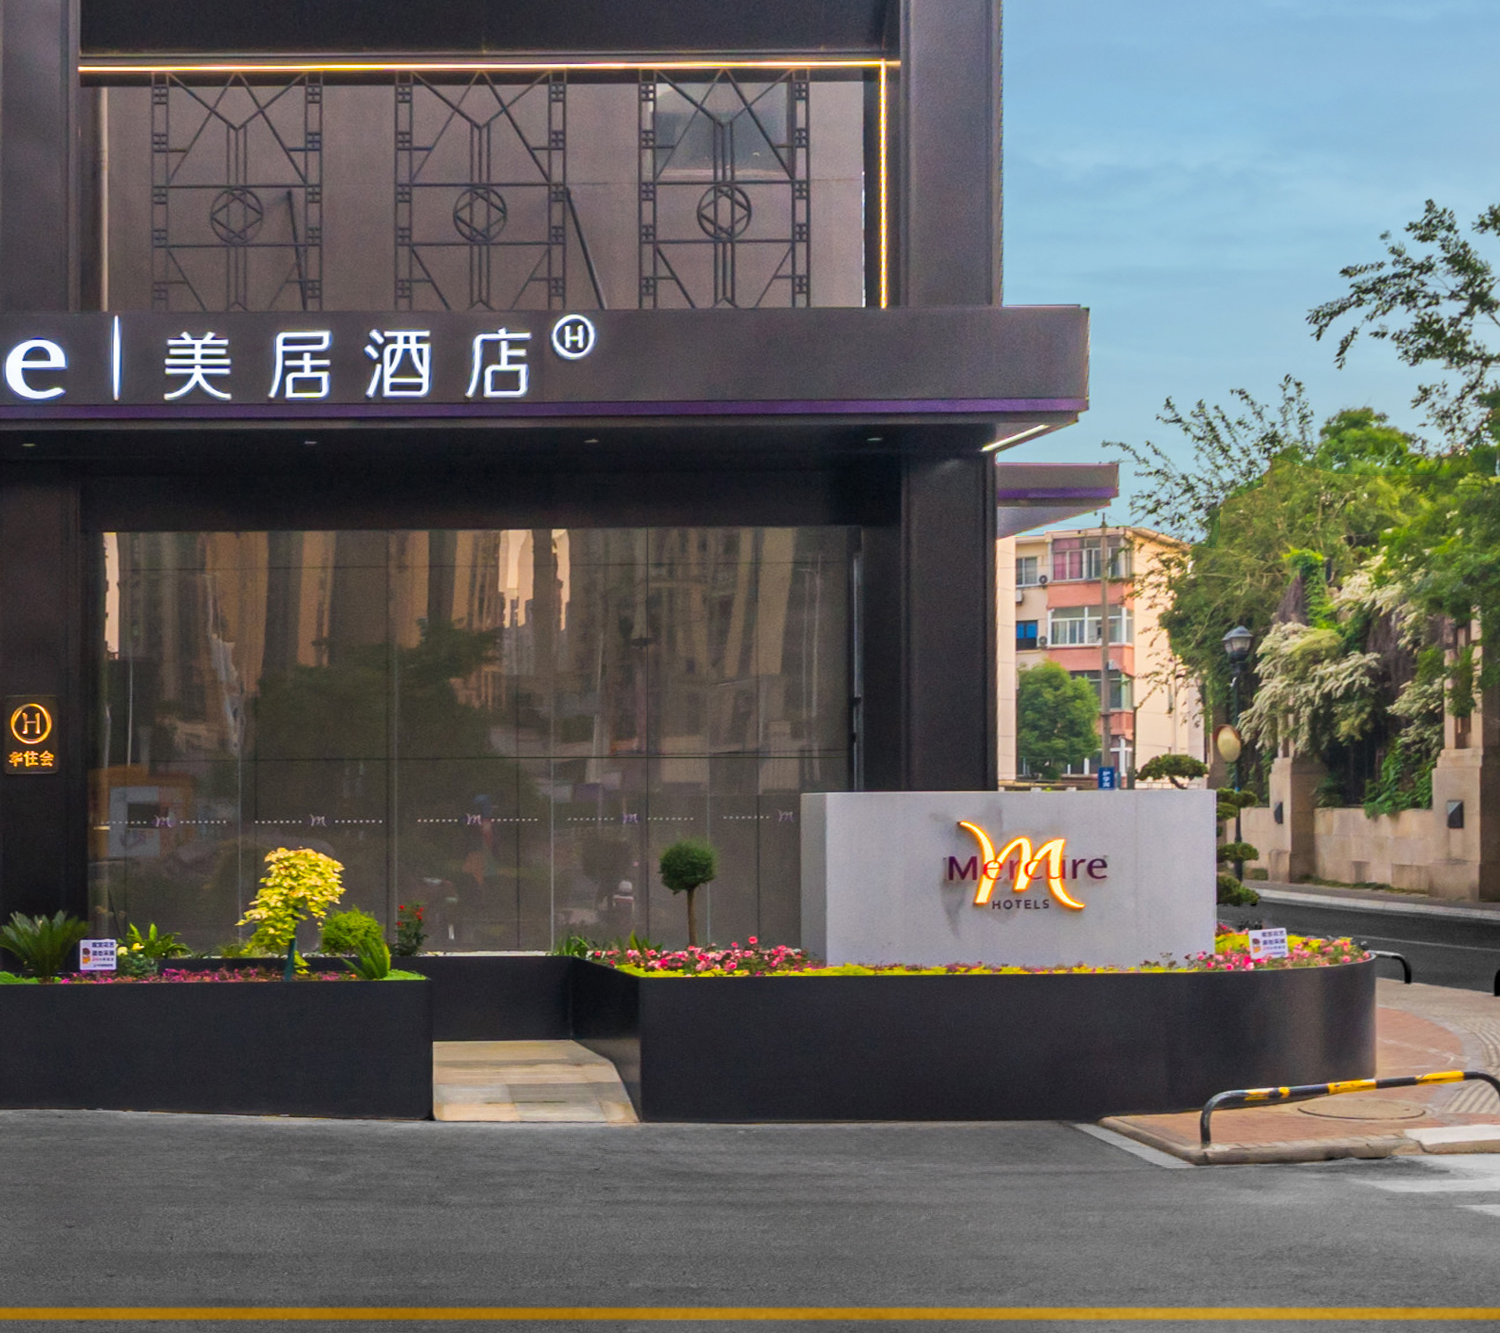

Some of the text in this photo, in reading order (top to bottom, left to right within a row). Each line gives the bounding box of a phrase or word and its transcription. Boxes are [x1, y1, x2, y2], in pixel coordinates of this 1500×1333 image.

[163, 328, 533, 402] 美居酒店
[8, 750, 55, 768] 华住会
[947, 855, 1109, 881] Mercure
[991, 899, 1051, 910] HOTELS
